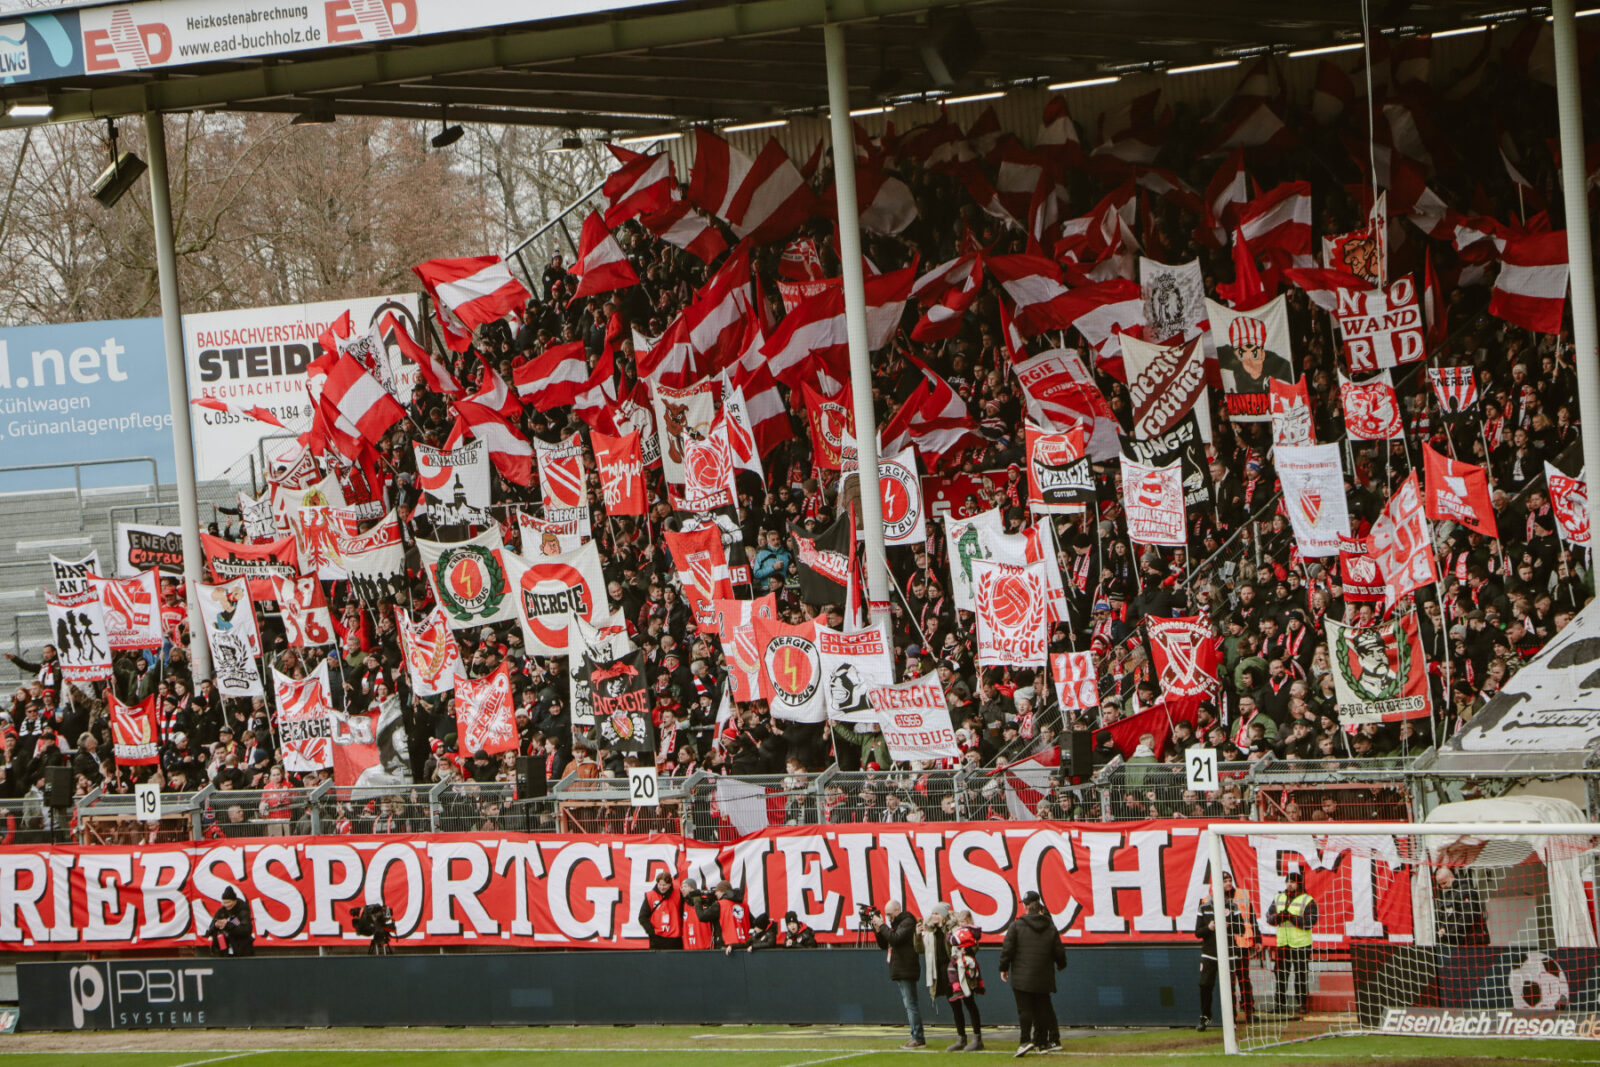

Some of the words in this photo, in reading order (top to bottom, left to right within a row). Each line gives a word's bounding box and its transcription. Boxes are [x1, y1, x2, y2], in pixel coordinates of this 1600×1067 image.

[186, 5, 308, 30] Heizkostenabrechnung
[83, 9, 173, 72] EAD
[179, 26, 321, 57] www.ead-buchholz.de
[197, 319, 356, 348] BAUSACHVERSTÄNDIR
[1342, 309, 1417, 335] WAND
[1432, 376, 1473, 387] ENERGIE
[280, 405, 299, 419] 184
[8, 412, 173, 437] Grünanlagenpflege
[1037, 458, 1094, 488] ENERGIE
[676, 493, 729, 512] ENERGIE
[449, 552, 482, 569] ENERGIE
[453, 586, 489, 607] COTTBUS
[522, 585, 588, 618] ENERGIE
[769, 636, 812, 653] ENERGIE
[821, 632, 881, 643] ENERGIE
[821, 643, 884, 653] COTTBUS
[592, 688, 650, 716] ENERGIE
[773, 682, 815, 704] COTTBUS
[869, 685, 946, 712] ENERGIE
[884, 728, 953, 746] COTTBUS
[1192, 757, 1214, 782] 21
[633, 775, 655, 799] 20
[140, 791, 156, 813] 19
[117, 968, 213, 1003] PBIT
[120, 1011, 205, 1024] SYSTEME
[1382, 1009, 1491, 1034] Eisenbach
